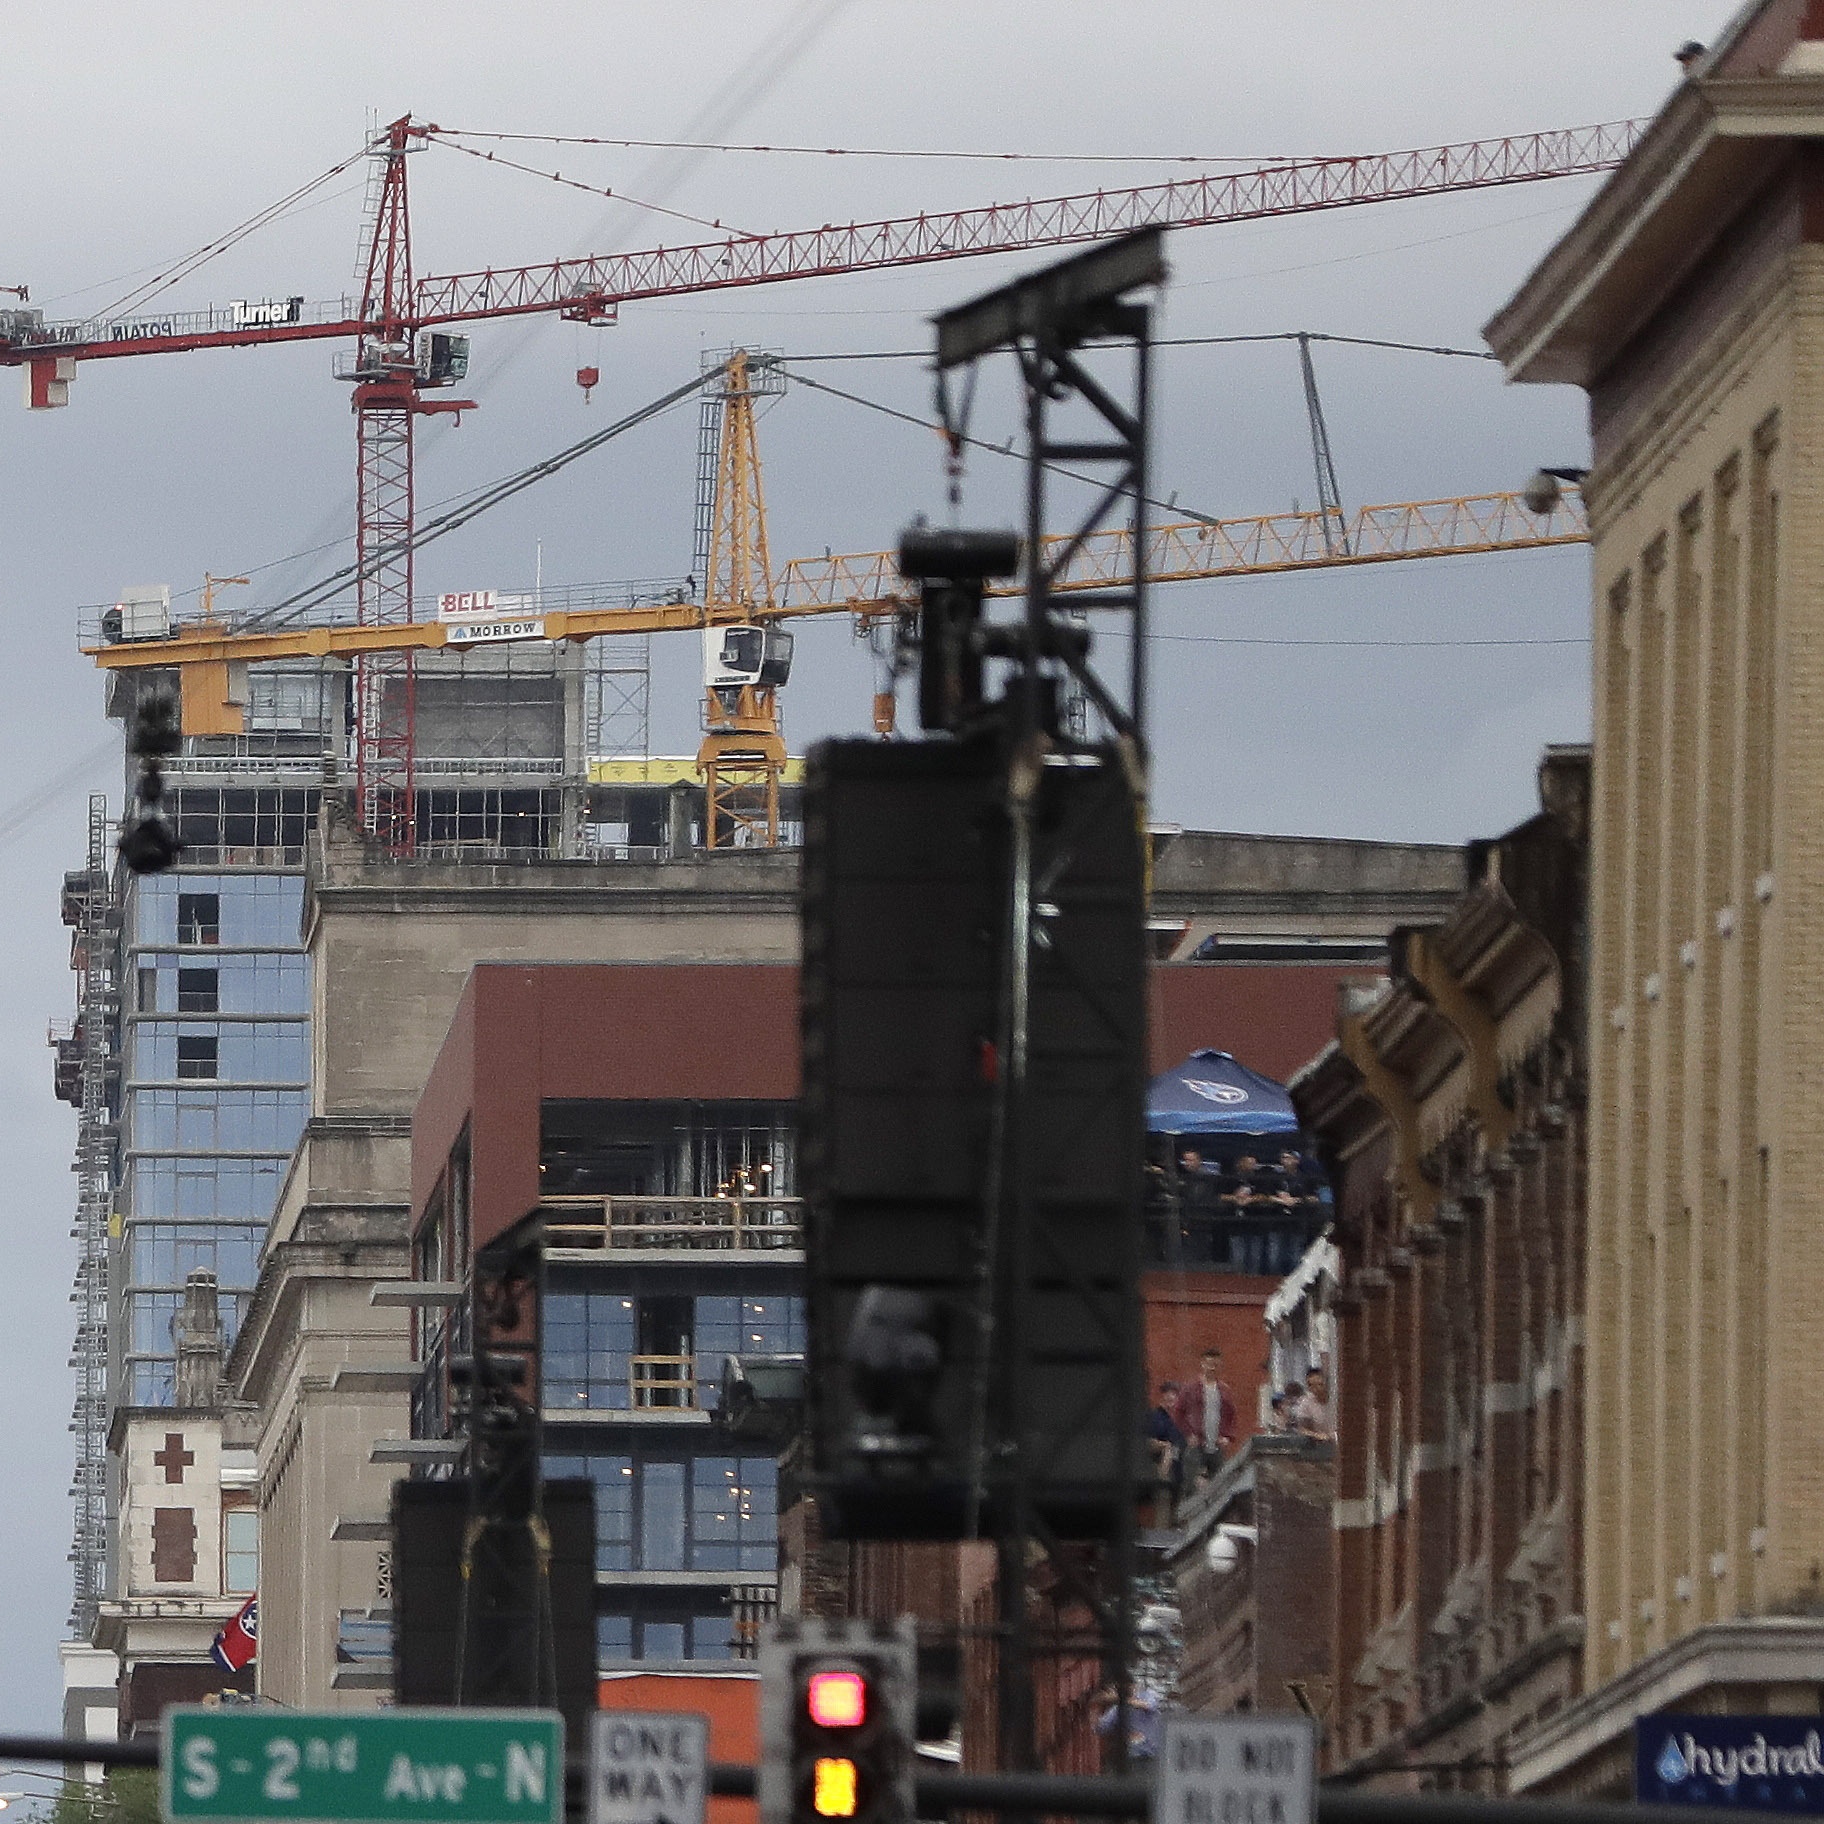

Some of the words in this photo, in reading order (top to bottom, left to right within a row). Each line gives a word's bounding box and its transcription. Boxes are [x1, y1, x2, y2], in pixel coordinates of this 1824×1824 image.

[441, 592, 495, 612] BELL
[470, 621, 538, 639] MORROW
[608, 1725, 694, 1767] ONE
[605, 1771, 695, 1807] WAY
